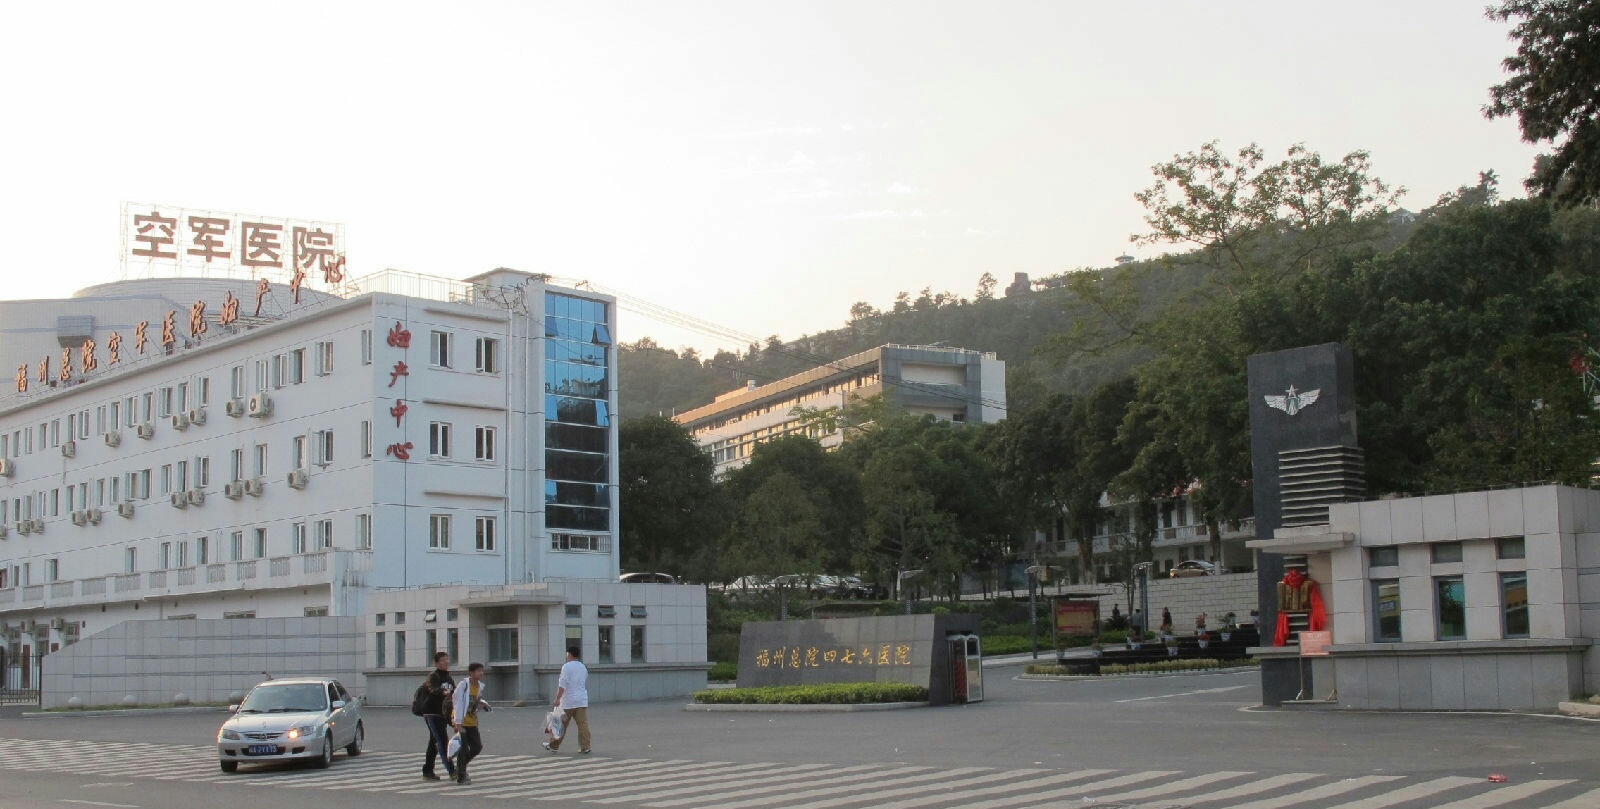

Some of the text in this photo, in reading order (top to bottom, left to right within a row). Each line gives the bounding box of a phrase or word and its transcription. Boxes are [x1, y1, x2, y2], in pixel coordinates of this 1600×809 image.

[132, 211, 334, 270] 空军医院
[387, 321, 413, 460] 妇产中心
[756, 644, 911, 669] 福州总院四七六医院
